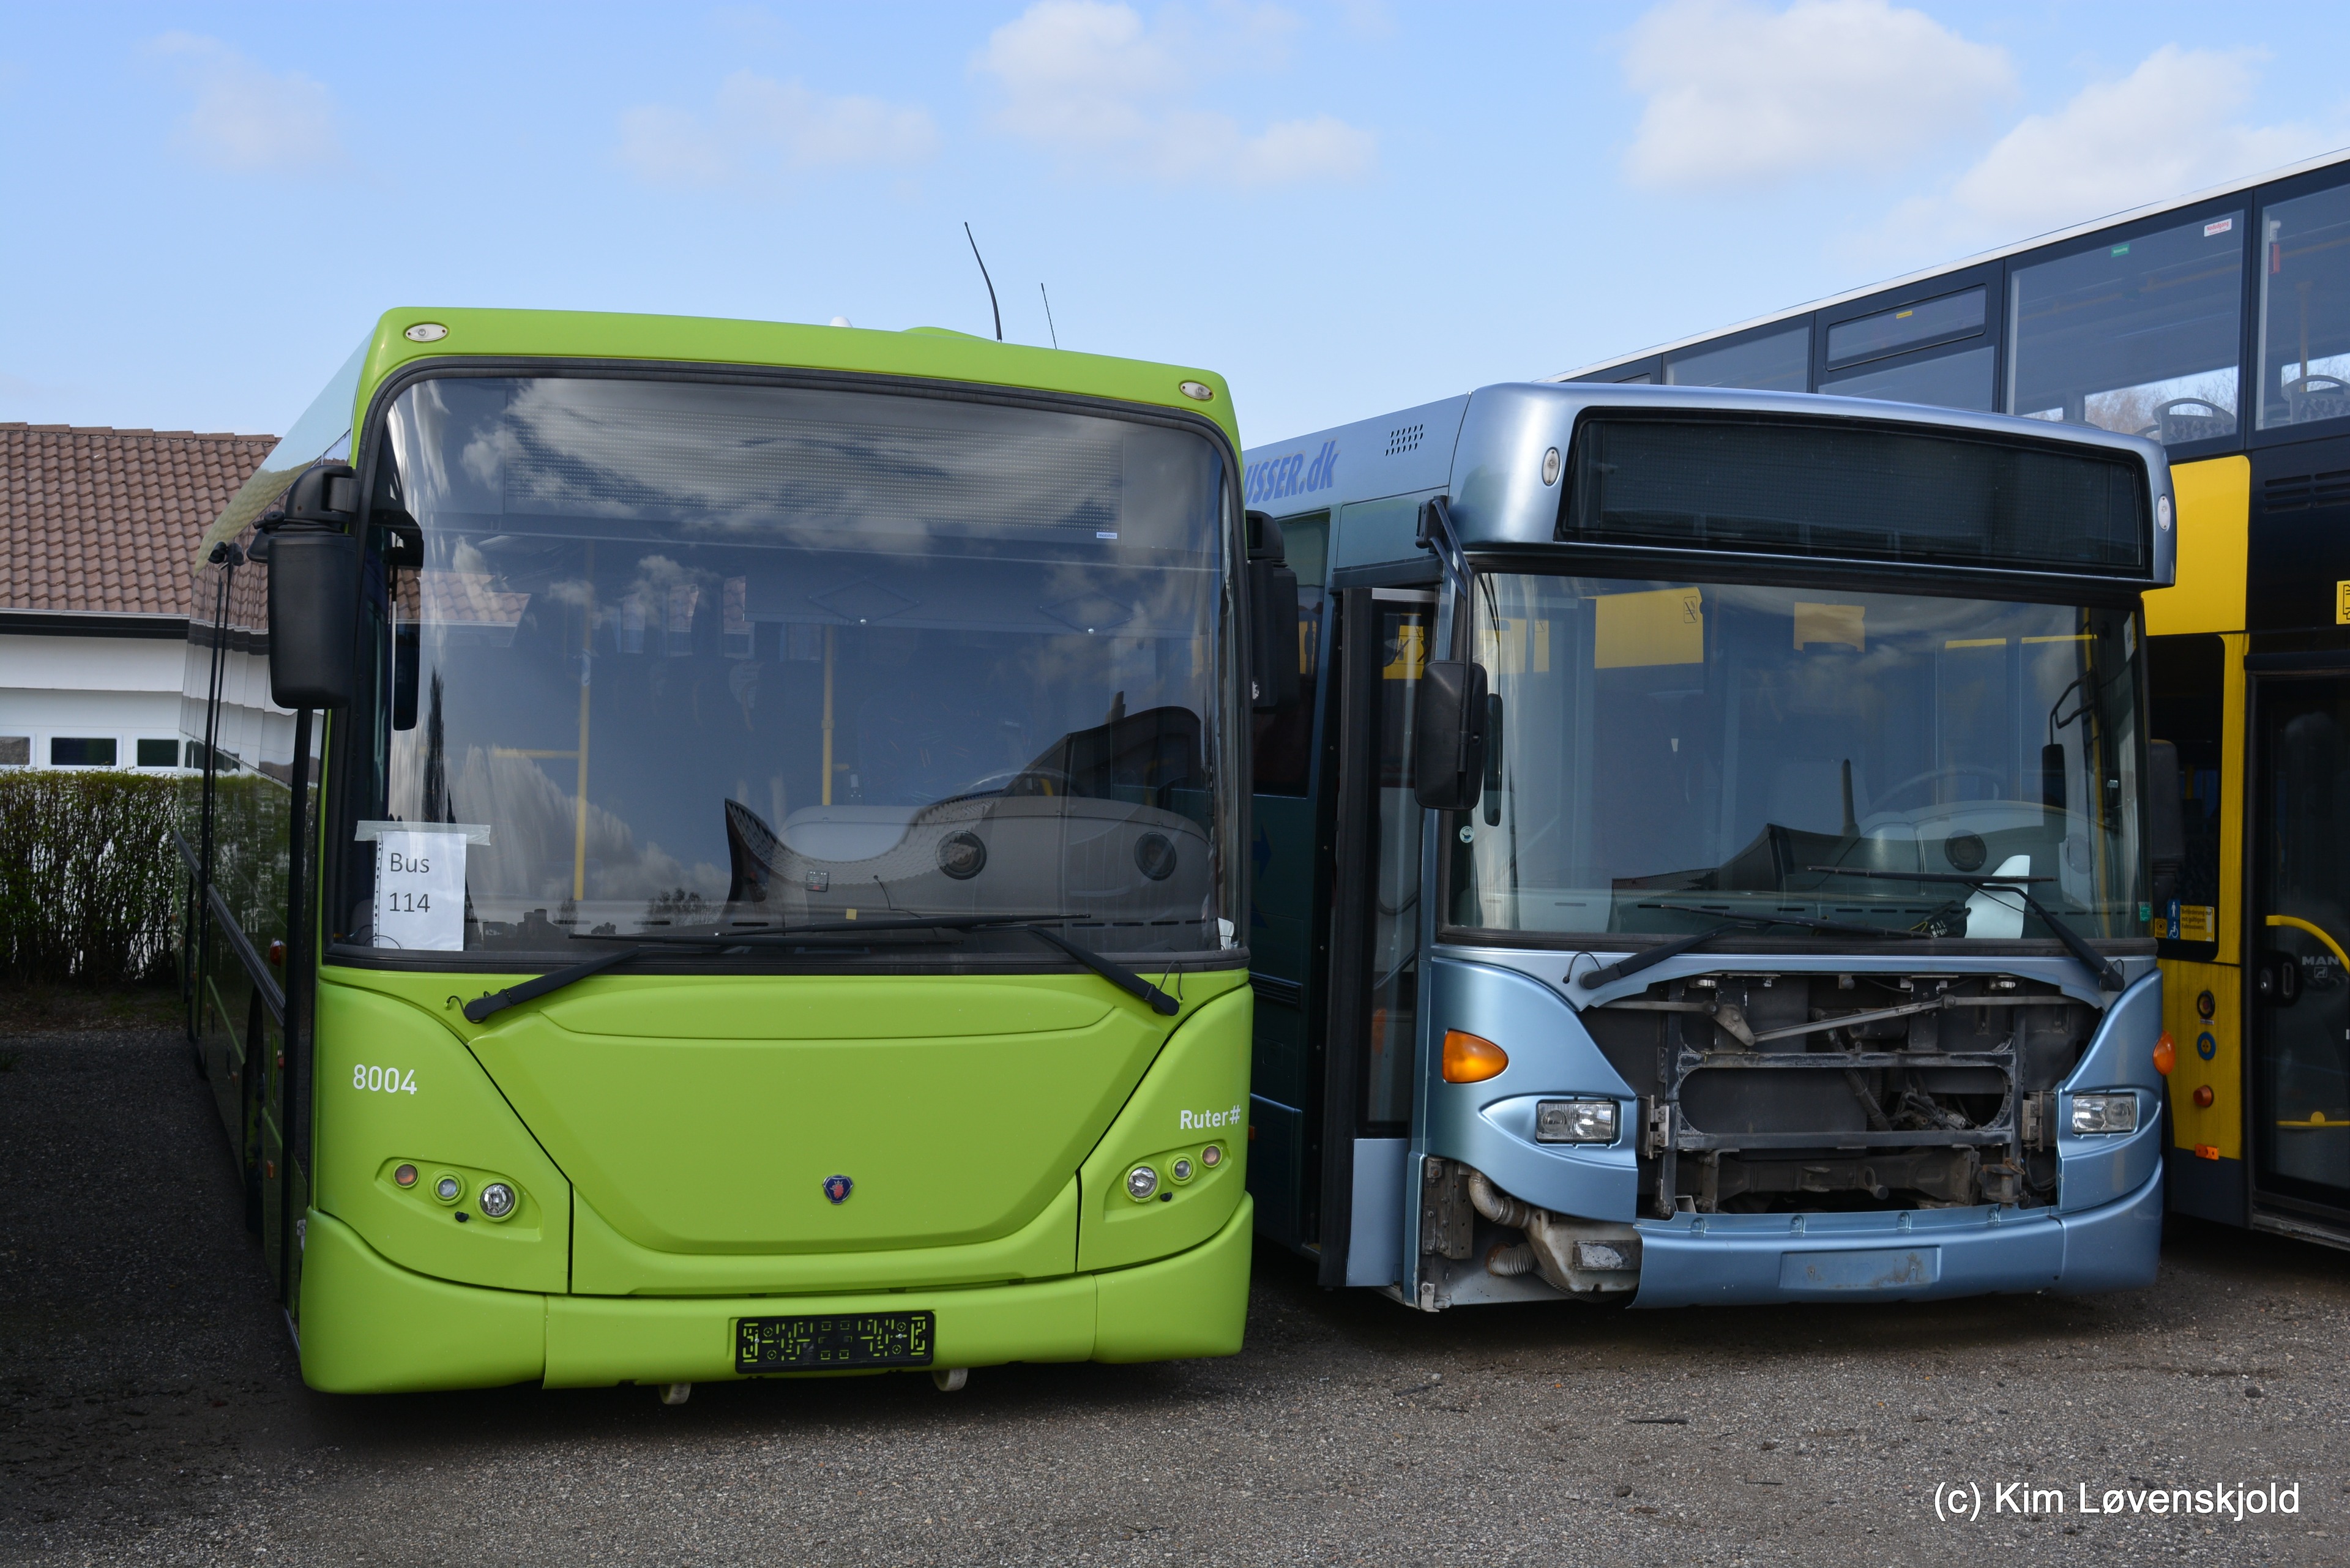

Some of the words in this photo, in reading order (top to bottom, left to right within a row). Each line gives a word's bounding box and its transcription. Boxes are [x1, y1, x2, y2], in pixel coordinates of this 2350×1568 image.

[1244, 437, 1341, 506] USSER.dk
[389, 852, 430, 873] Bus
[389, 892, 431, 913] 114
[2302, 955, 2340, 966] MAN
[352, 1064, 417, 1095] 8004
[1180, 1104, 1241, 1130] Ruter#
